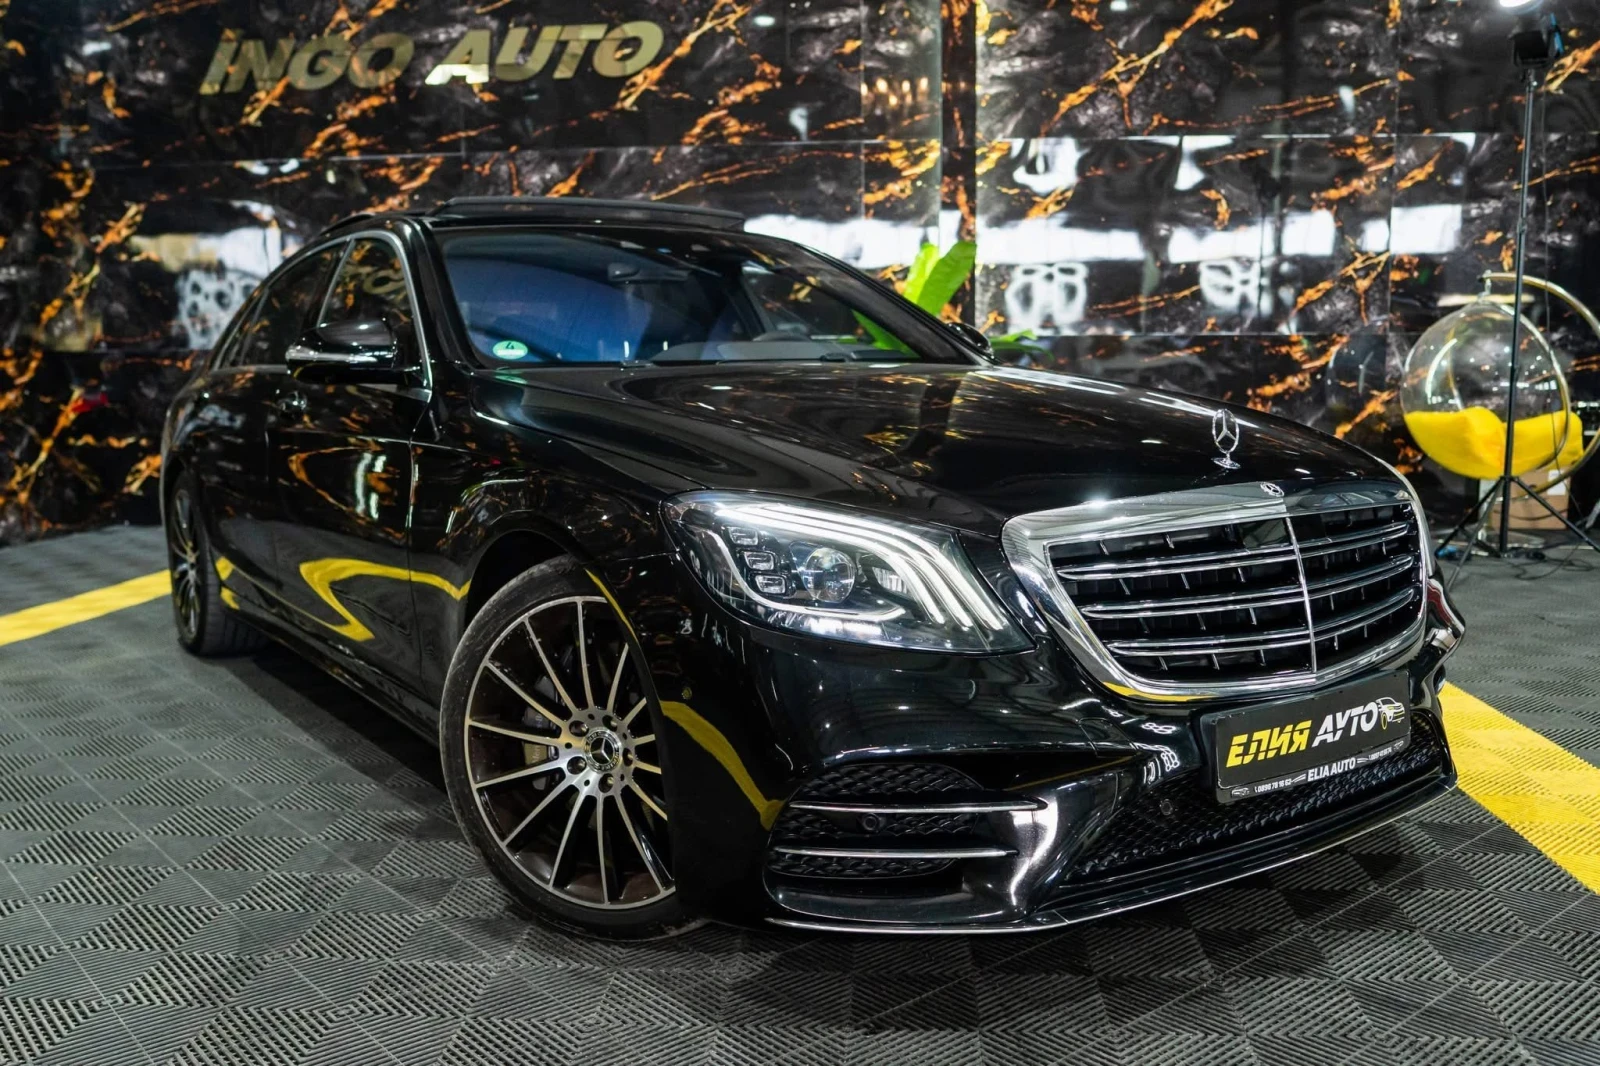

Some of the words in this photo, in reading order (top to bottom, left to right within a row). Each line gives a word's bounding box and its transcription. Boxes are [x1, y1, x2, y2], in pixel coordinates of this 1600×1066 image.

[424, 21, 664, 85] AUTO
[1226, 720, 1312, 768] ЕЛИЯ
[1307, 765, 1330, 782] ELIA
[1330, 757, 1356, 776] AUTO
